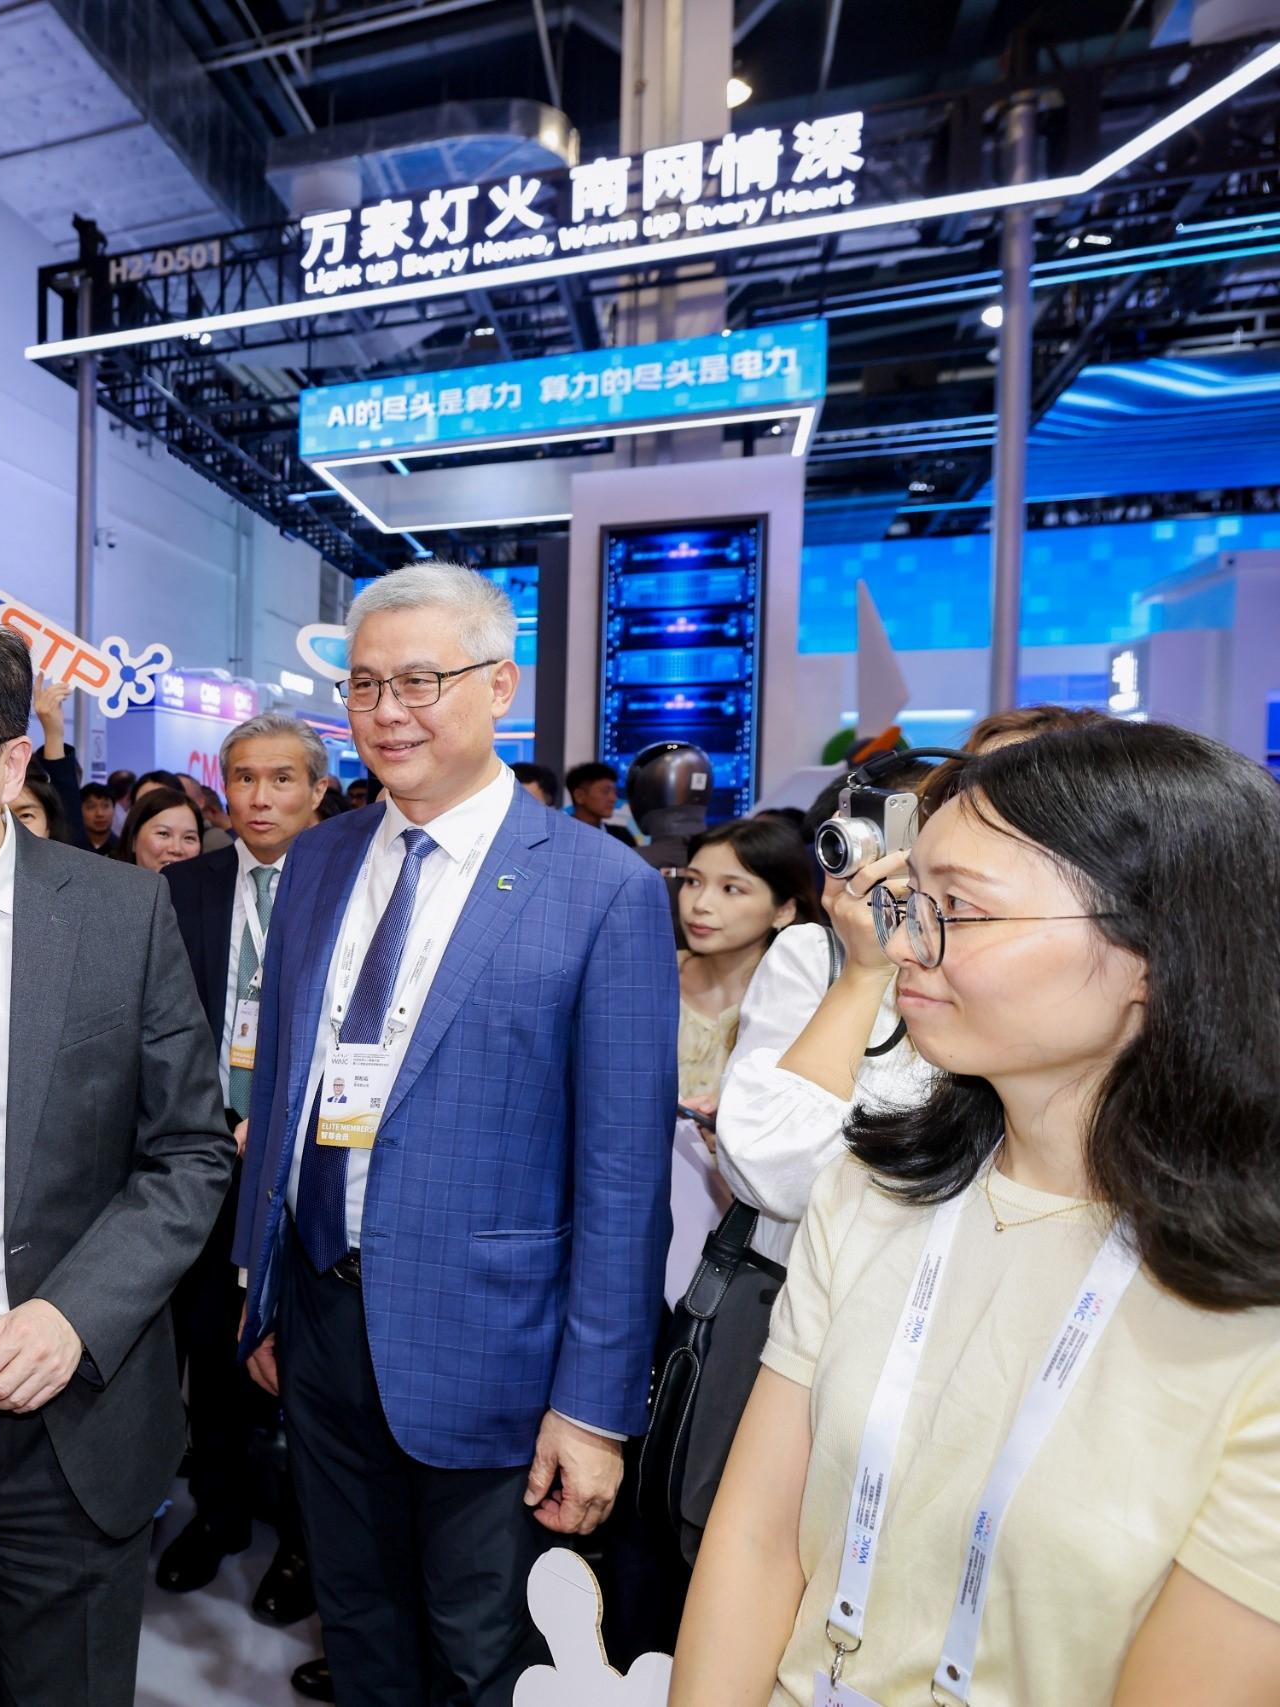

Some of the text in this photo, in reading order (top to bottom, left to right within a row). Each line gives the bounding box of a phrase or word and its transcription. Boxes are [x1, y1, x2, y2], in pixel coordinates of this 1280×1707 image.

[300, 111, 864, 270] 万家灯火 南网情深
[305, 180, 855, 294] Light up Every Home, Warm up Every Heart
[327, 346, 797, 430] AI的尽头是算力 算力的尽头是电力
[910, 1315, 925, 1343] WAIC
[1073, 1291, 1096, 1321] WAIC
[857, 1535, 872, 1565] WAIC
